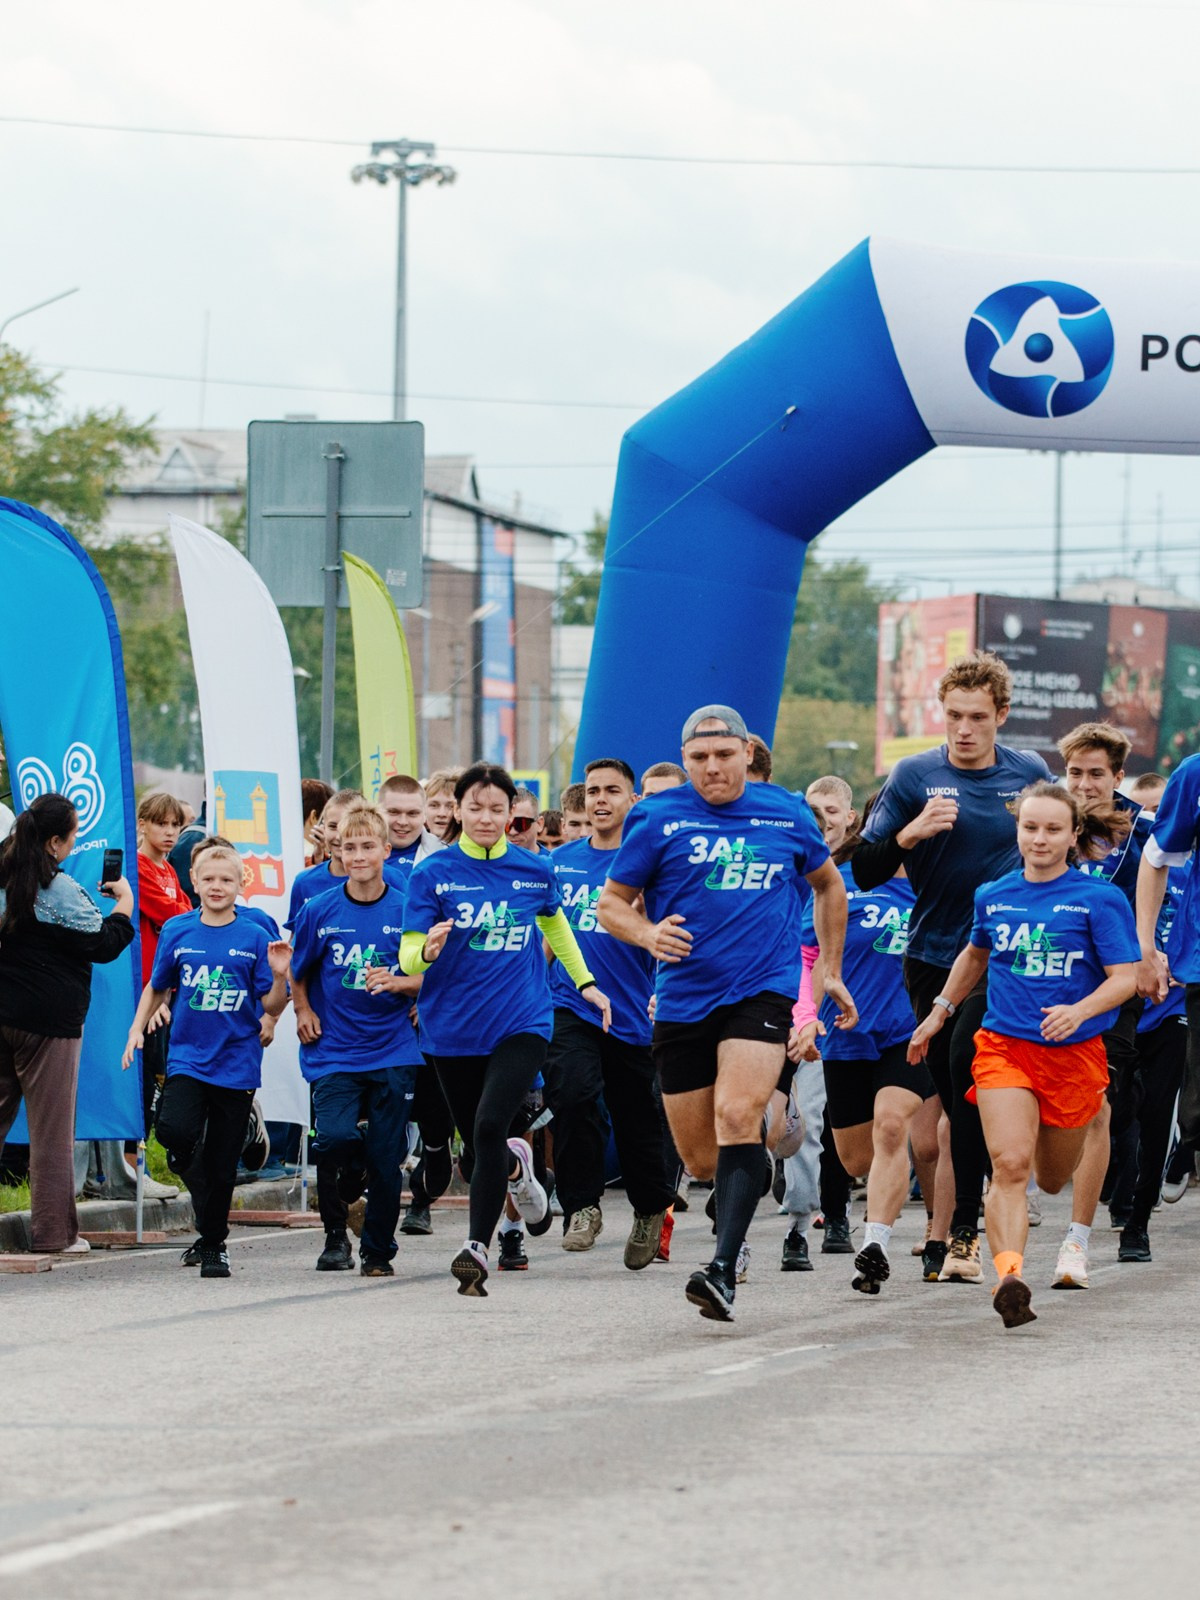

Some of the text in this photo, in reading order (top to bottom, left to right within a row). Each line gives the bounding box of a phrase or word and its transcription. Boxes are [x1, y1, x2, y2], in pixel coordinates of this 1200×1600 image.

[926, 787, 960, 796] LUKOIL
[687, 835, 746, 865] ЗА!
[720, 862, 785, 890] БЕГ
[454, 901, 508, 930] ЗА!
[994, 922, 1046, 952] ЗА!
[182, 964, 224, 989] ЗА!
[1024, 950, 1084, 978] БЕГ
[200, 988, 248, 1013] БЕГ
